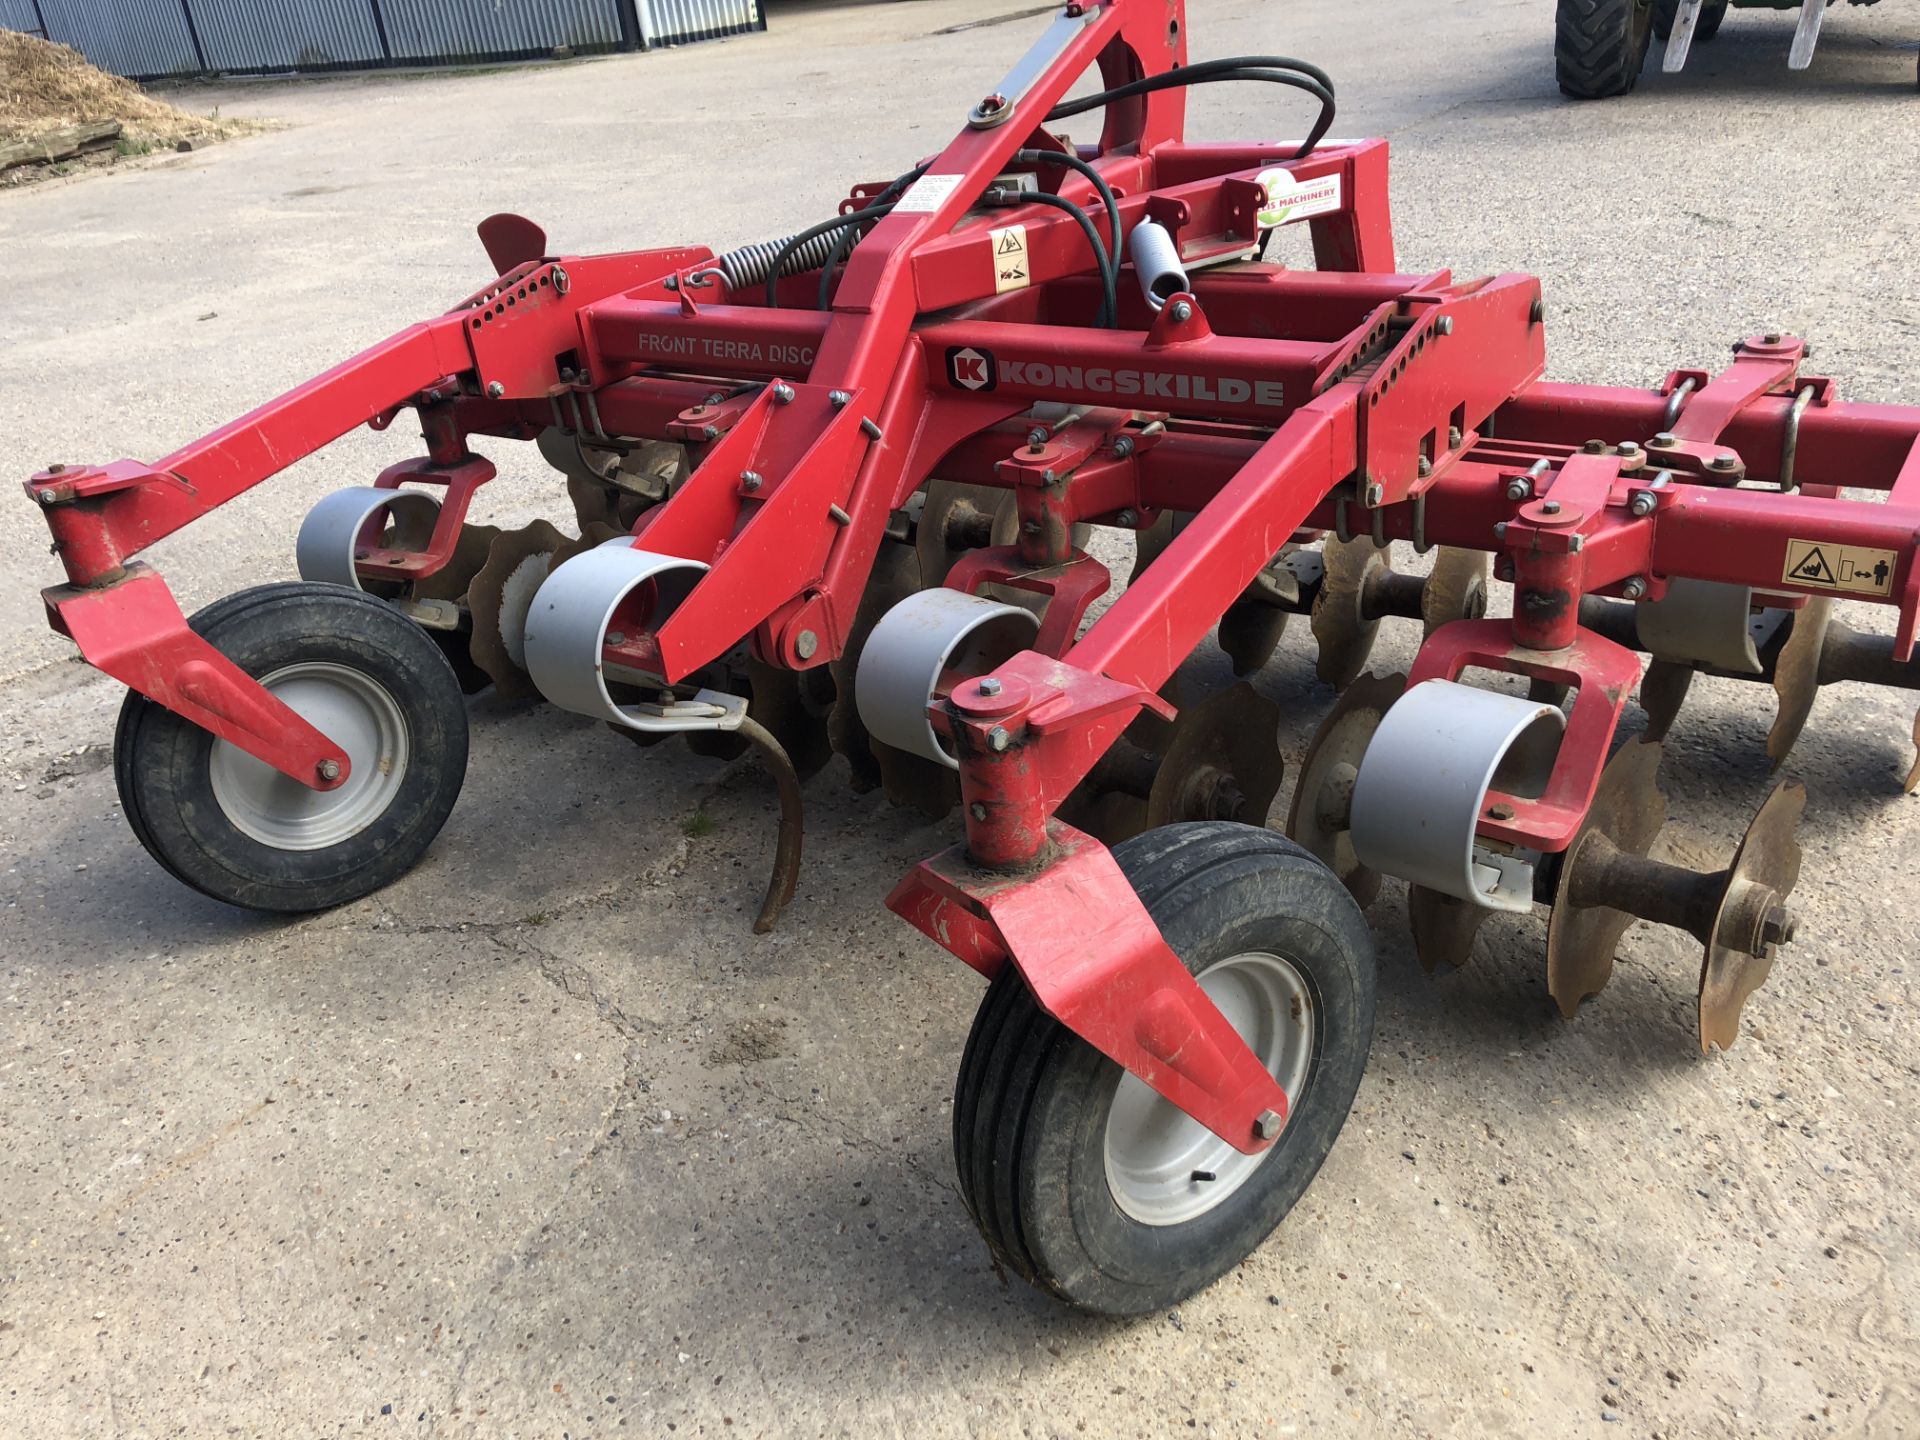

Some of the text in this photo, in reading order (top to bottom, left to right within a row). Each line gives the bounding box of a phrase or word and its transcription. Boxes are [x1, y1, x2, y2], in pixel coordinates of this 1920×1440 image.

[1279, 188, 1335, 207] MACHINERY
[639, 333, 813, 365] FRONT TERRA DISC
[956, 357, 1284, 406] K KONGSKILDE
